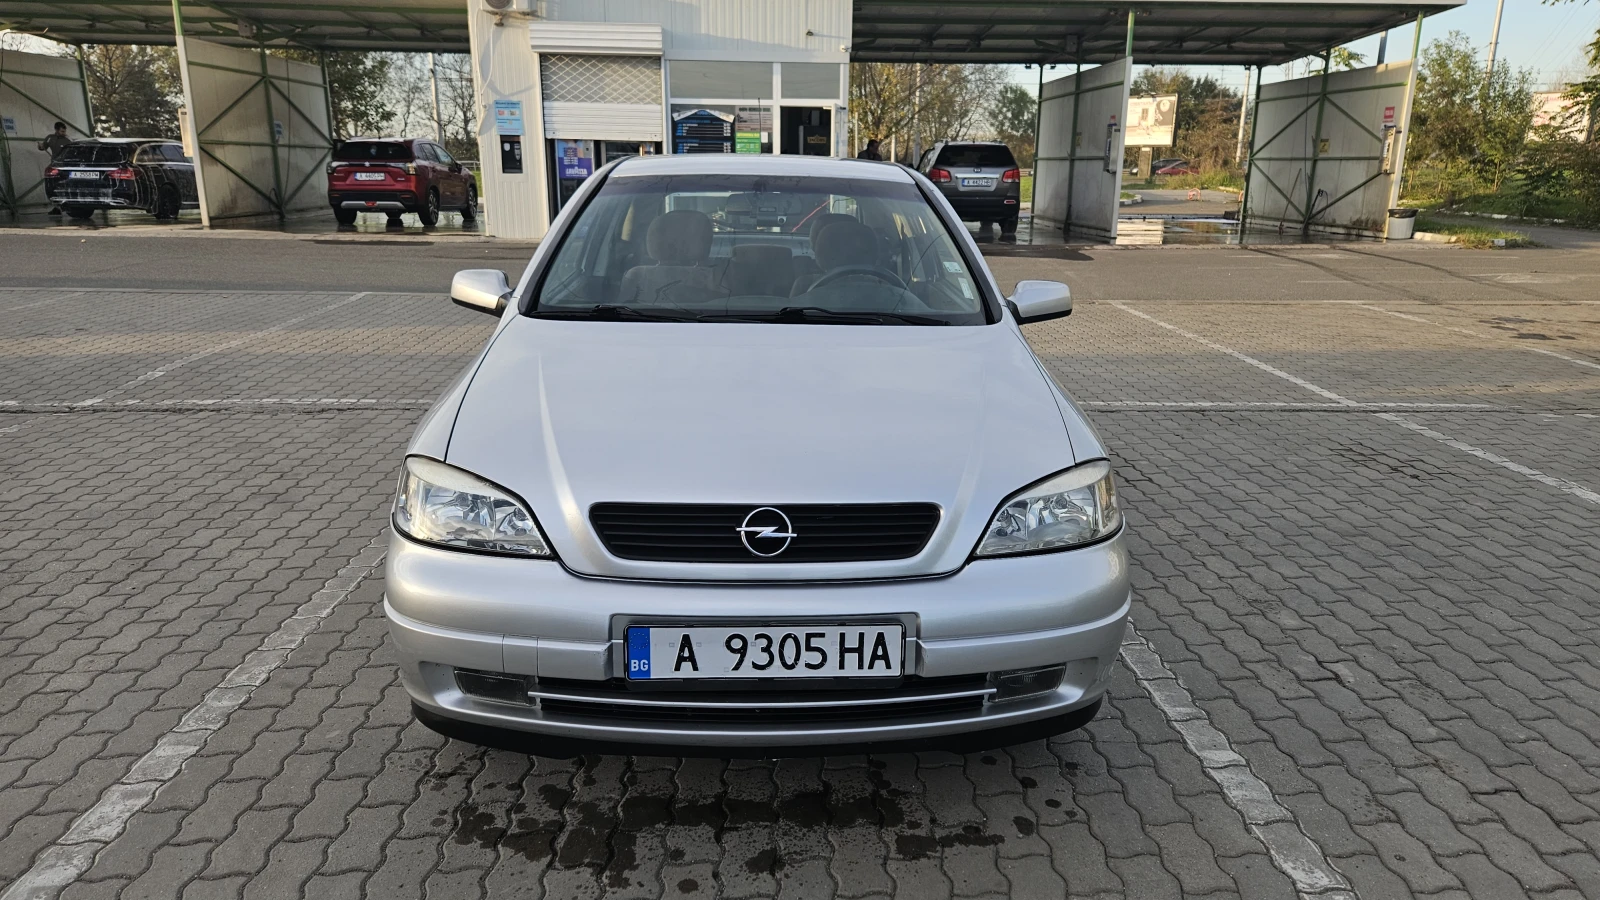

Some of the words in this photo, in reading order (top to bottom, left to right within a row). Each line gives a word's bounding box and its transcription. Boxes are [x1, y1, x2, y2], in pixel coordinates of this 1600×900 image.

[673, 633, 699, 671] A
[724, 632, 828, 672] 9305
[838, 631, 892, 671] HA
[630, 659, 649, 671] BG
